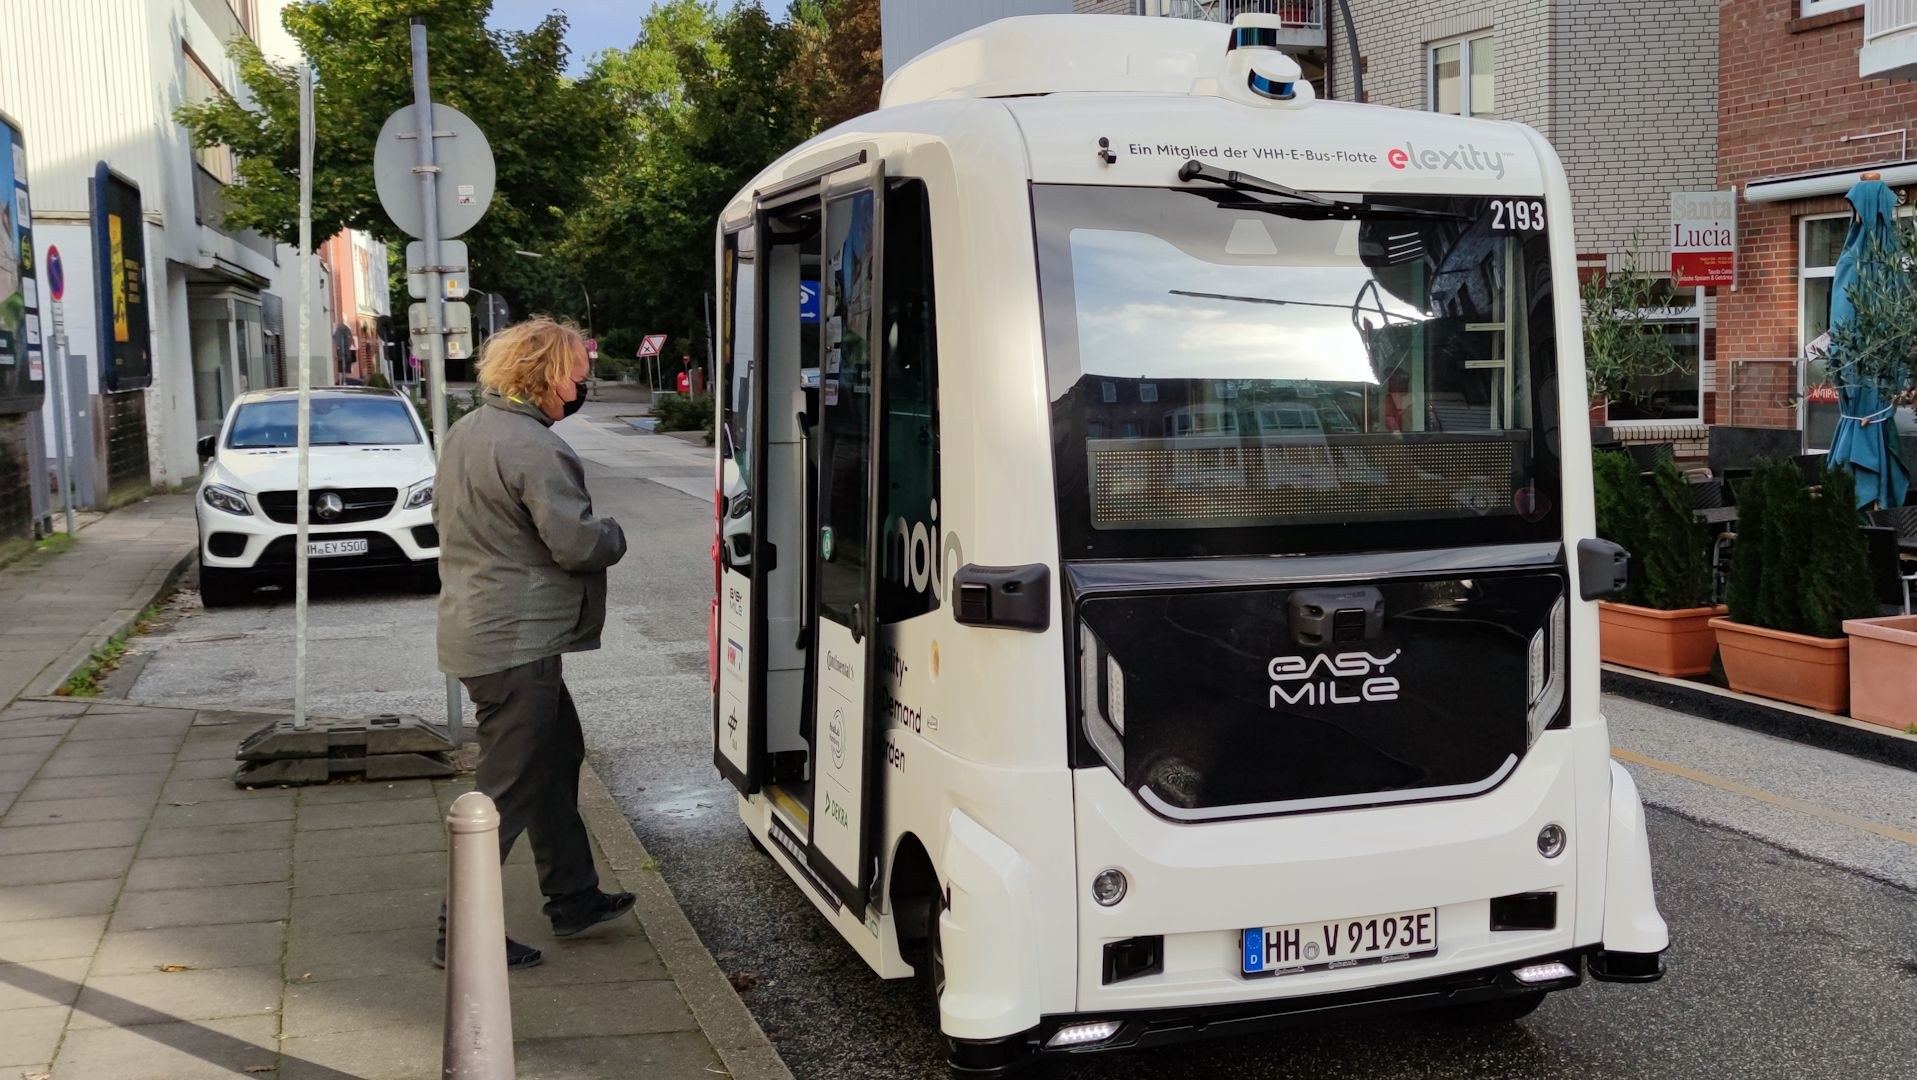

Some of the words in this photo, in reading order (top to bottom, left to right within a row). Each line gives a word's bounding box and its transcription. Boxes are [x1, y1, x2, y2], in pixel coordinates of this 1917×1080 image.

[1129, 143, 1152, 155] Ein
[1157, 144, 1218, 159] Mitglied
[1223, 146, 1248, 158] der
[1252, 147, 1377, 164] VHH-E-Bus-Flotte
[1387, 141, 1505, 180] elexity
[1489, 200, 1545, 231] 2193
[1672, 194, 1731, 220] Santa
[1674, 222, 1732, 247] Lucia
[325, 543, 338, 553] EY
[340, 541, 367, 552] 5500
[882, 498, 963, 602] moin
[831, 799, 848, 830] DEKRA
[1250, 954, 1258, 965] D
[1265, 928, 1300, 963] HH
[1323, 924, 1339, 956] V
[1347, 913, 1432, 953] 9193E
